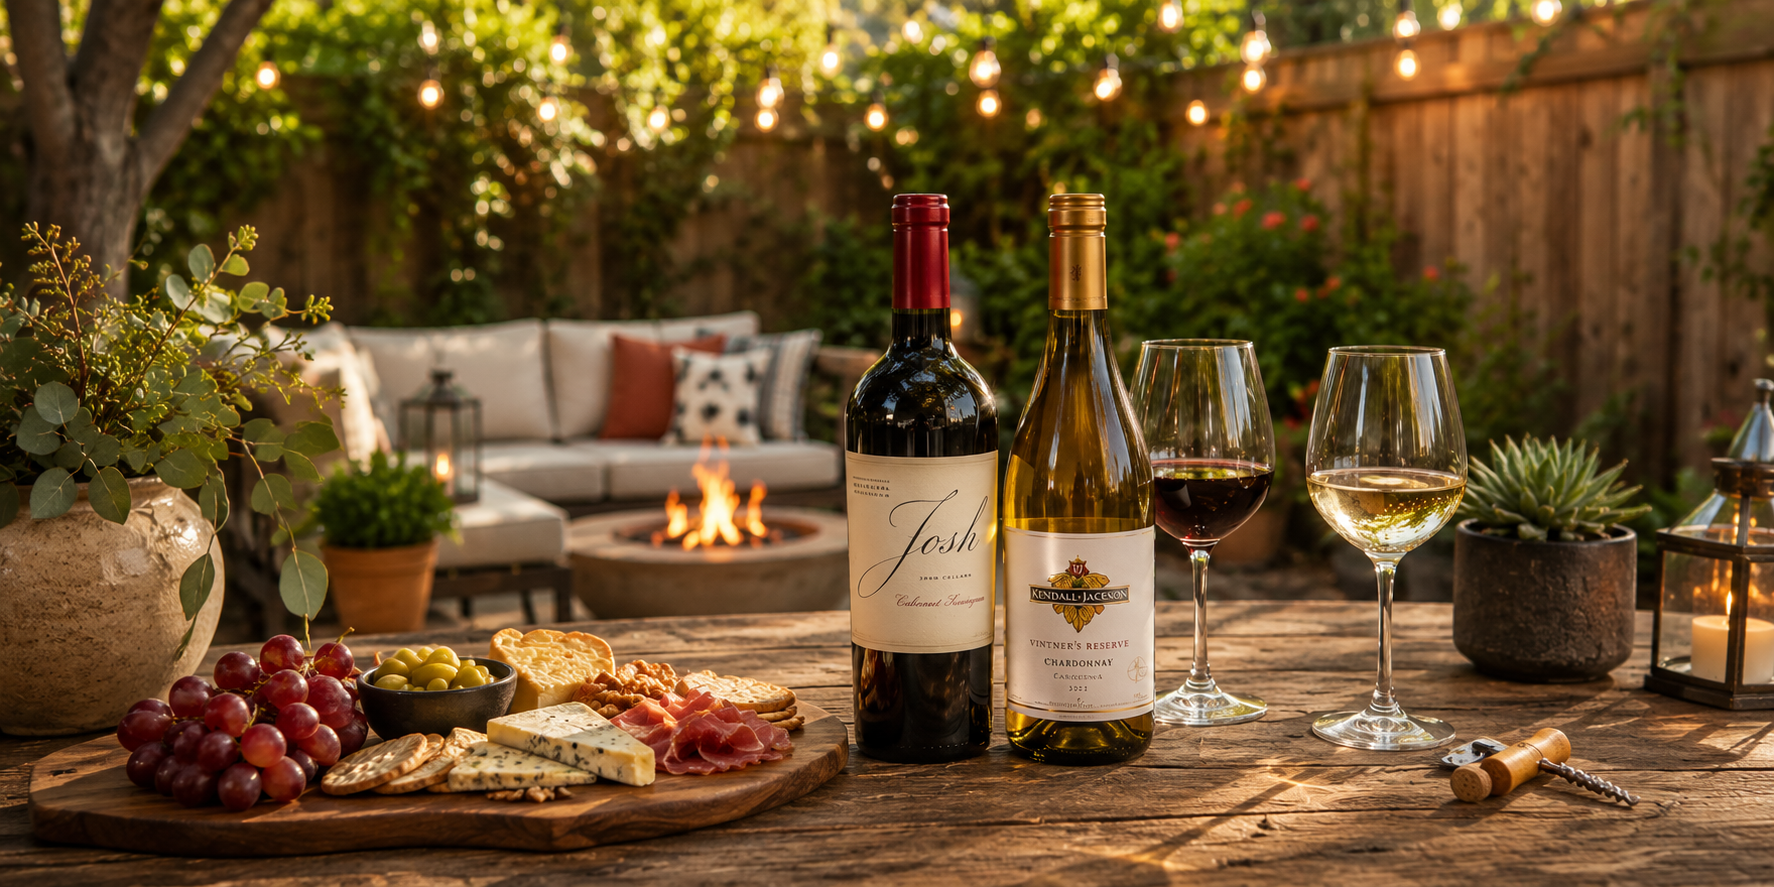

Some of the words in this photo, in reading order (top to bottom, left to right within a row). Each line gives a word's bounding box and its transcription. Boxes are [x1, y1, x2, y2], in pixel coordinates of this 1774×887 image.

[858, 489, 988, 599] Josh
[1029, 639, 1082, 650] VINTNER'S
[1086, 639, 1130, 650] RESERVE
[1044, 657, 1114, 667] CHARDONNAY
